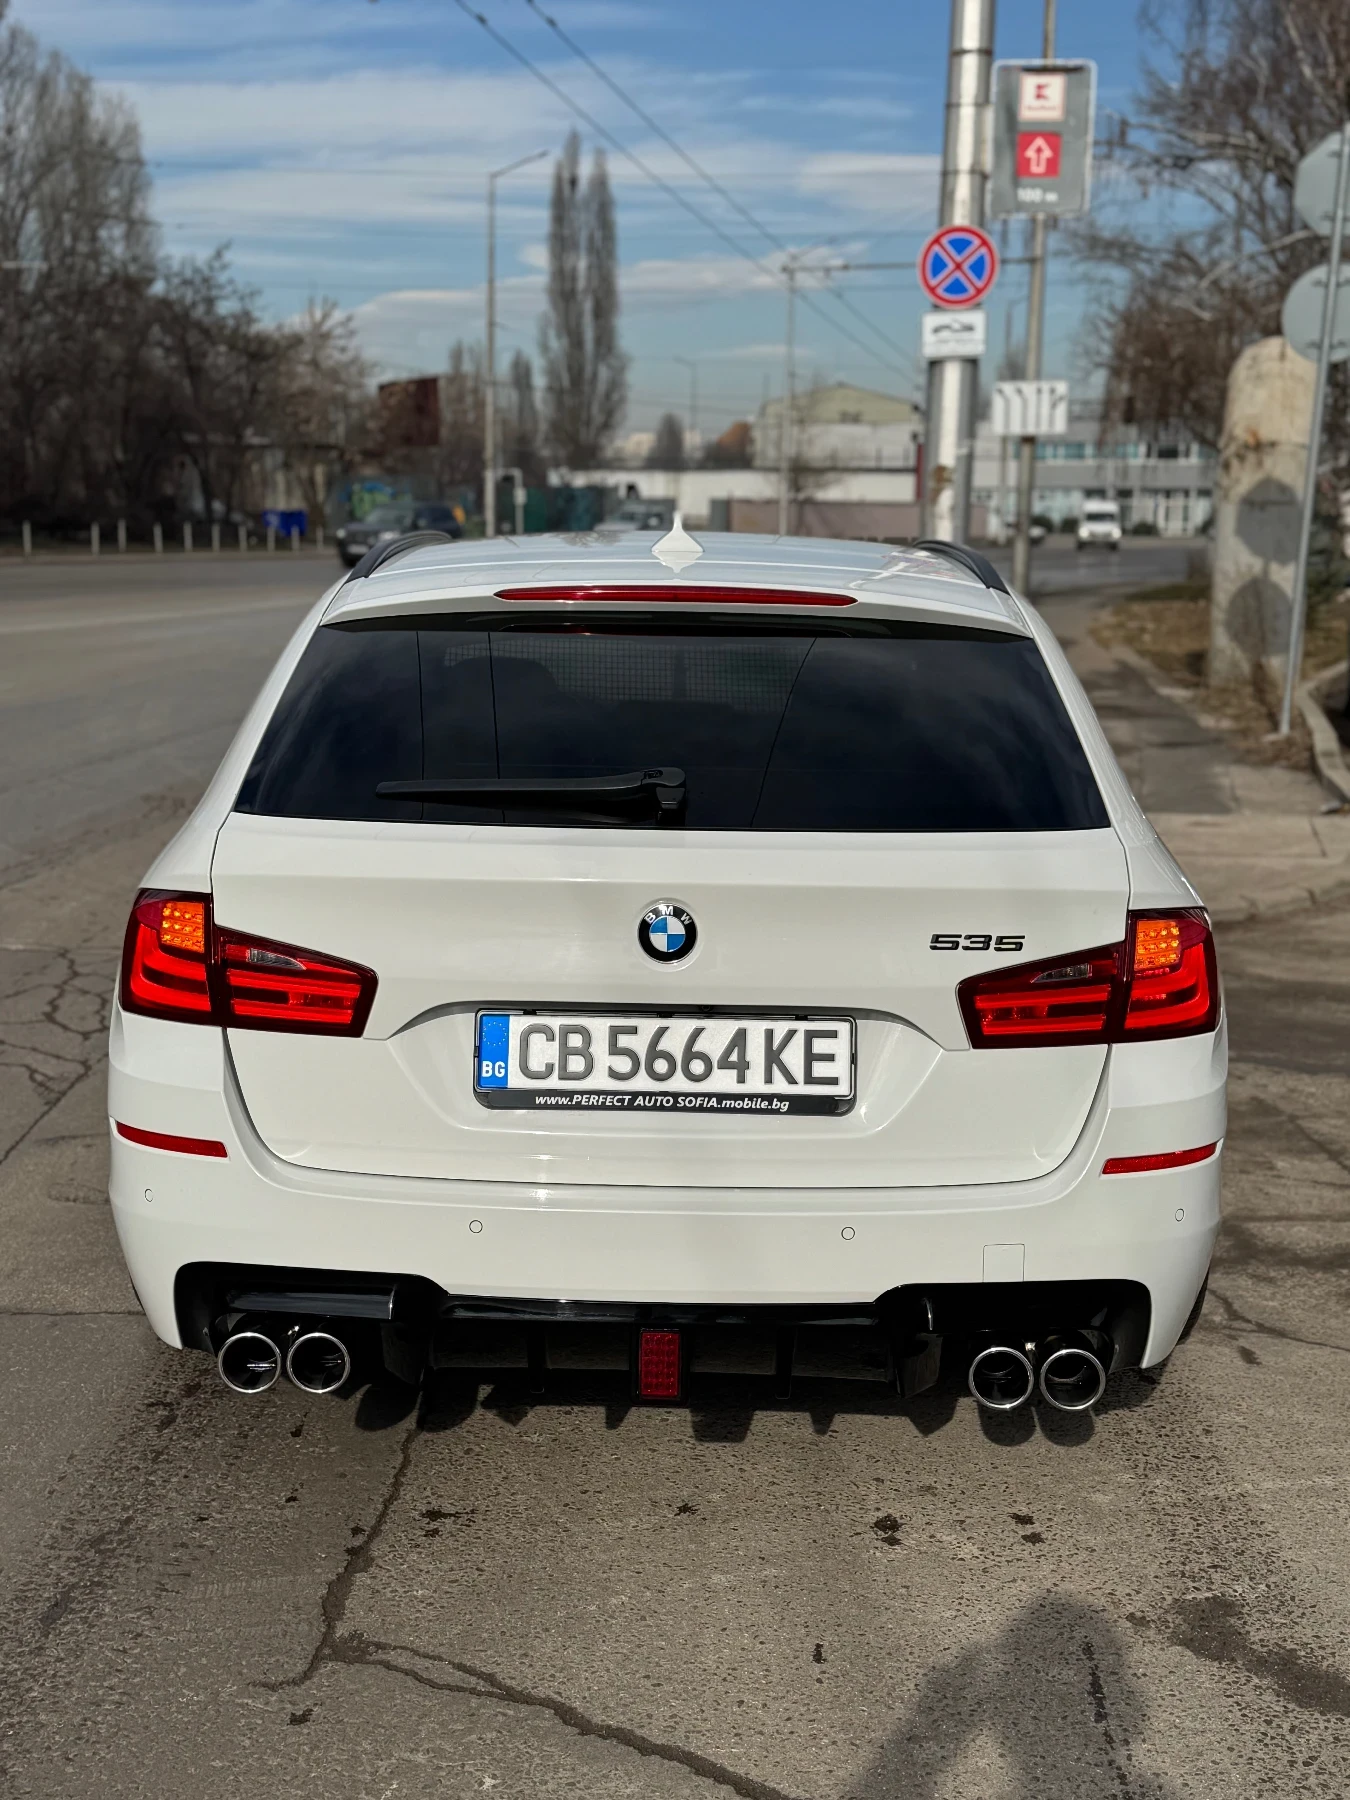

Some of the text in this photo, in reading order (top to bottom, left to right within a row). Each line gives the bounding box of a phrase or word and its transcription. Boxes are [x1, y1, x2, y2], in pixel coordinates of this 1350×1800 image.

[644, 905, 693, 925] BMW
[929, 934, 1025, 952] 535
[481, 1060, 506, 1078] BG
[535, 1094, 790, 1112] www.PERFECT AUTO SOFIA.mobile.bg
